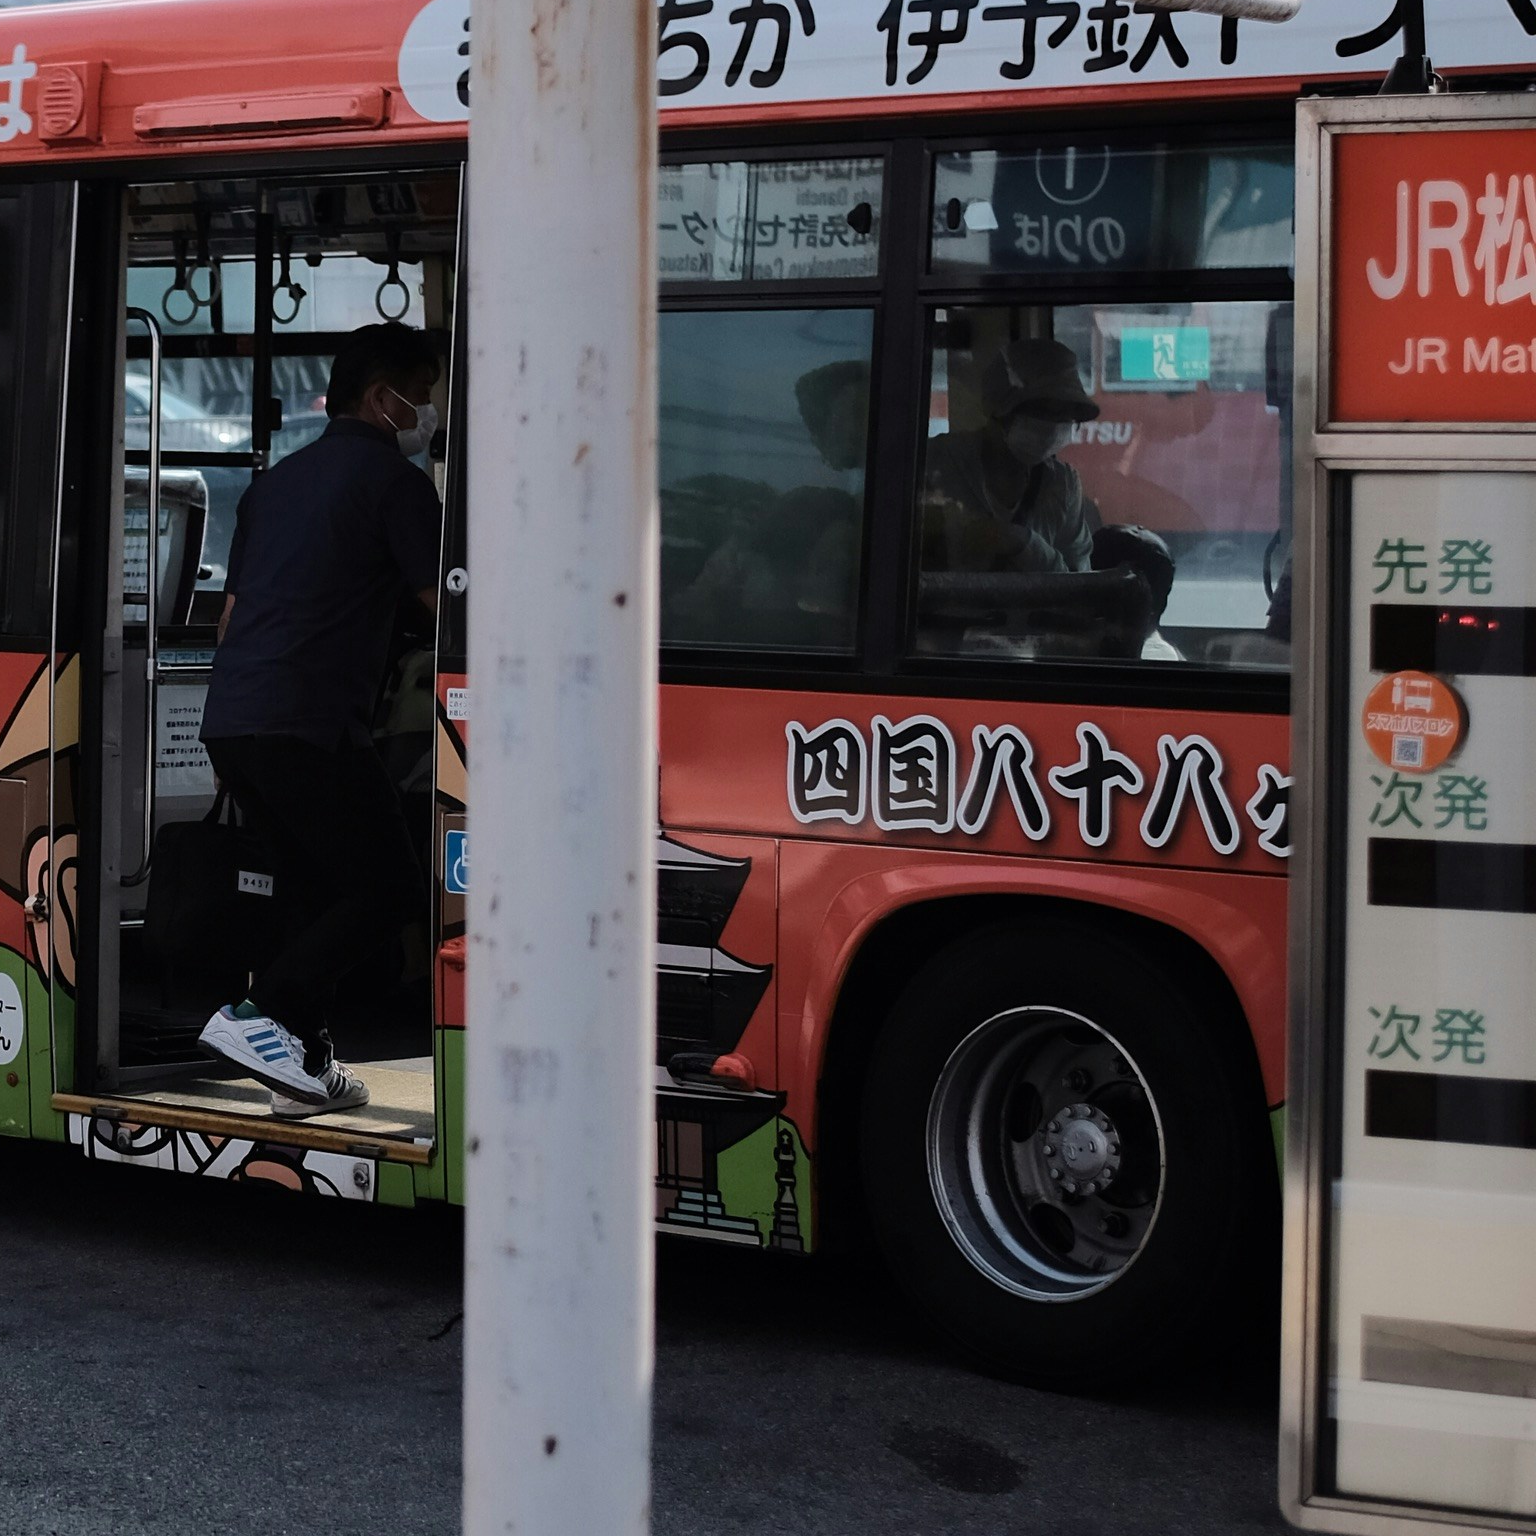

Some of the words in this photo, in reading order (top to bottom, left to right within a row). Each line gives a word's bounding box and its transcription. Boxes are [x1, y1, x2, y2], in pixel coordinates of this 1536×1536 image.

[1366, 172, 1536, 306] JR松
[1388, 337, 1448, 375] JR
[1372, 537, 1494, 596] 先発
[1366, 712, 1453, 737] スマホバスロケ
[1369, 772, 1489, 832] 次発
[243, 877, 270, 889] 9457
[1366, 1004, 1487, 1065] 次発
